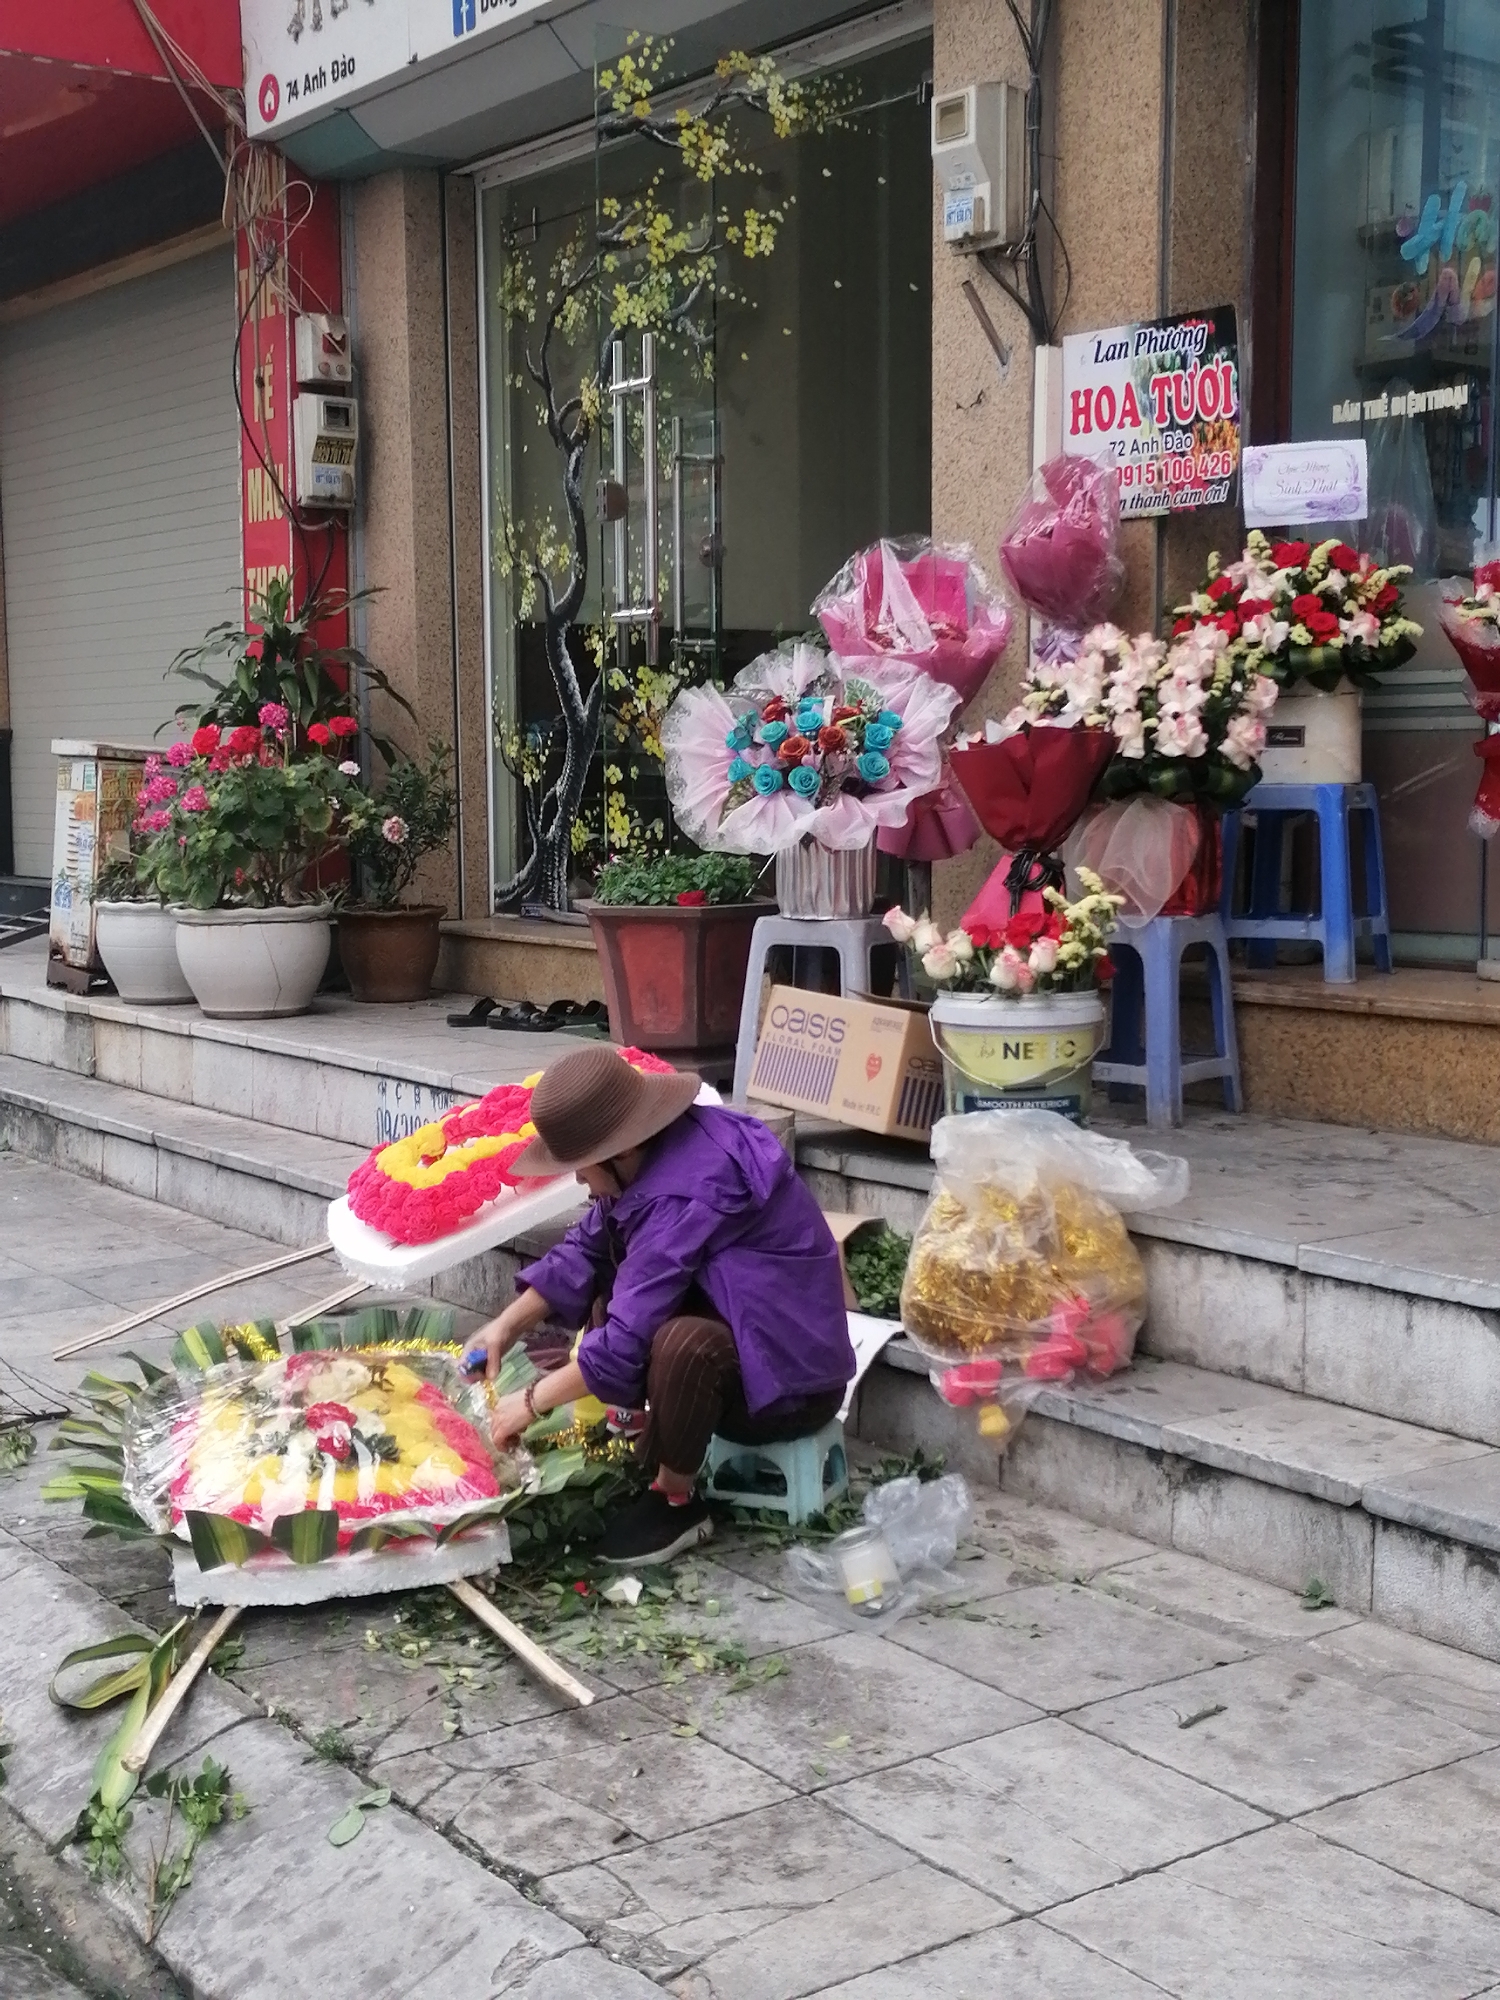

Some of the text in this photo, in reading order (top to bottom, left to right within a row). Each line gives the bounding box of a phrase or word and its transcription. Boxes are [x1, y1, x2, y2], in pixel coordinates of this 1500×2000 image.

[286, 53, 355, 104] 74 Anh Đào
[1094, 325, 1206, 364] Lan Phương
[1070, 358, 1233, 435] HOA TƯƠI
[1109, 431, 1193, 457] 72 Anh Đào
[1116, 452, 1231, 487] 0915 106 426
[765, 1031, 842, 1056] FLORAL FOAM
